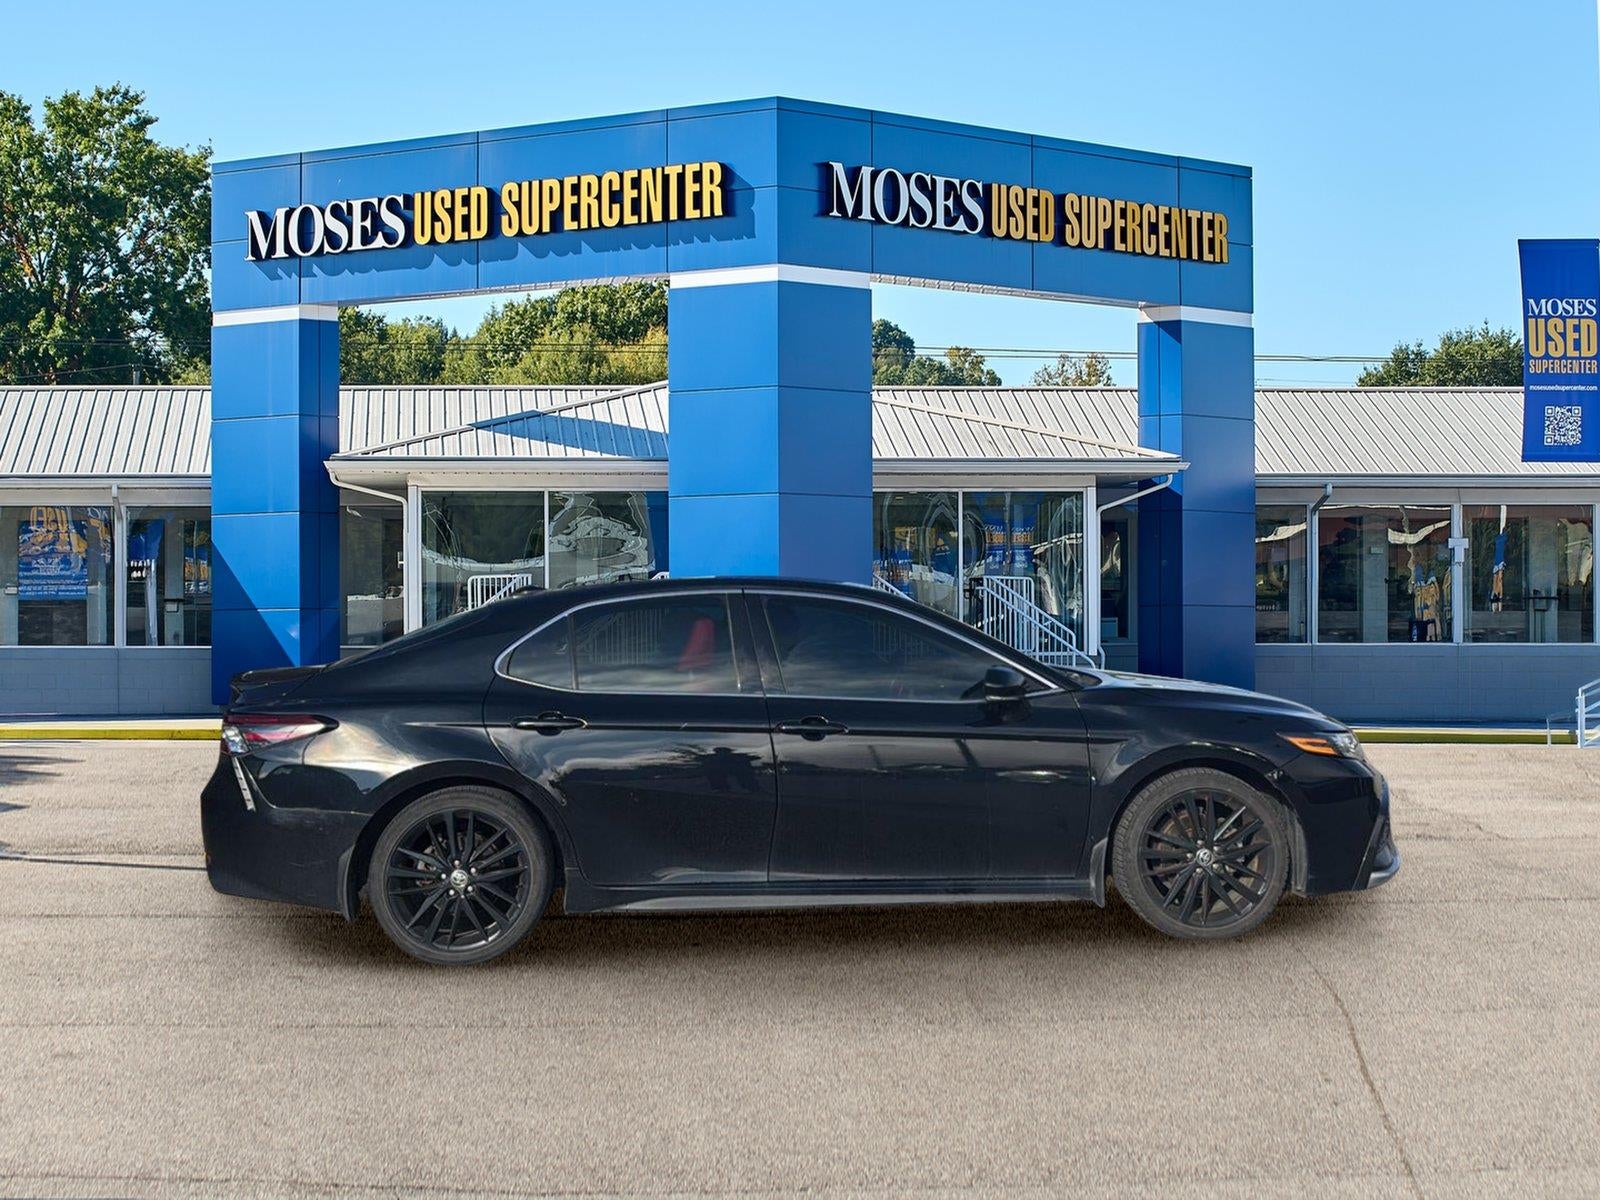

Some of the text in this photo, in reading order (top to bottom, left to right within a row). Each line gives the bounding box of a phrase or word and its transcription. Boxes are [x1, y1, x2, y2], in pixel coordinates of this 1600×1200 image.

[245, 161, 724, 262] MOSES USED SUPERCENTER
[829, 161, 1230, 264] MOSES USED SUPERCENTER
[1527, 298, 1597, 317] MOSES
[1528, 318, 1598, 358] USED
[1529, 359, 1598, 374] SUPERCENTER
